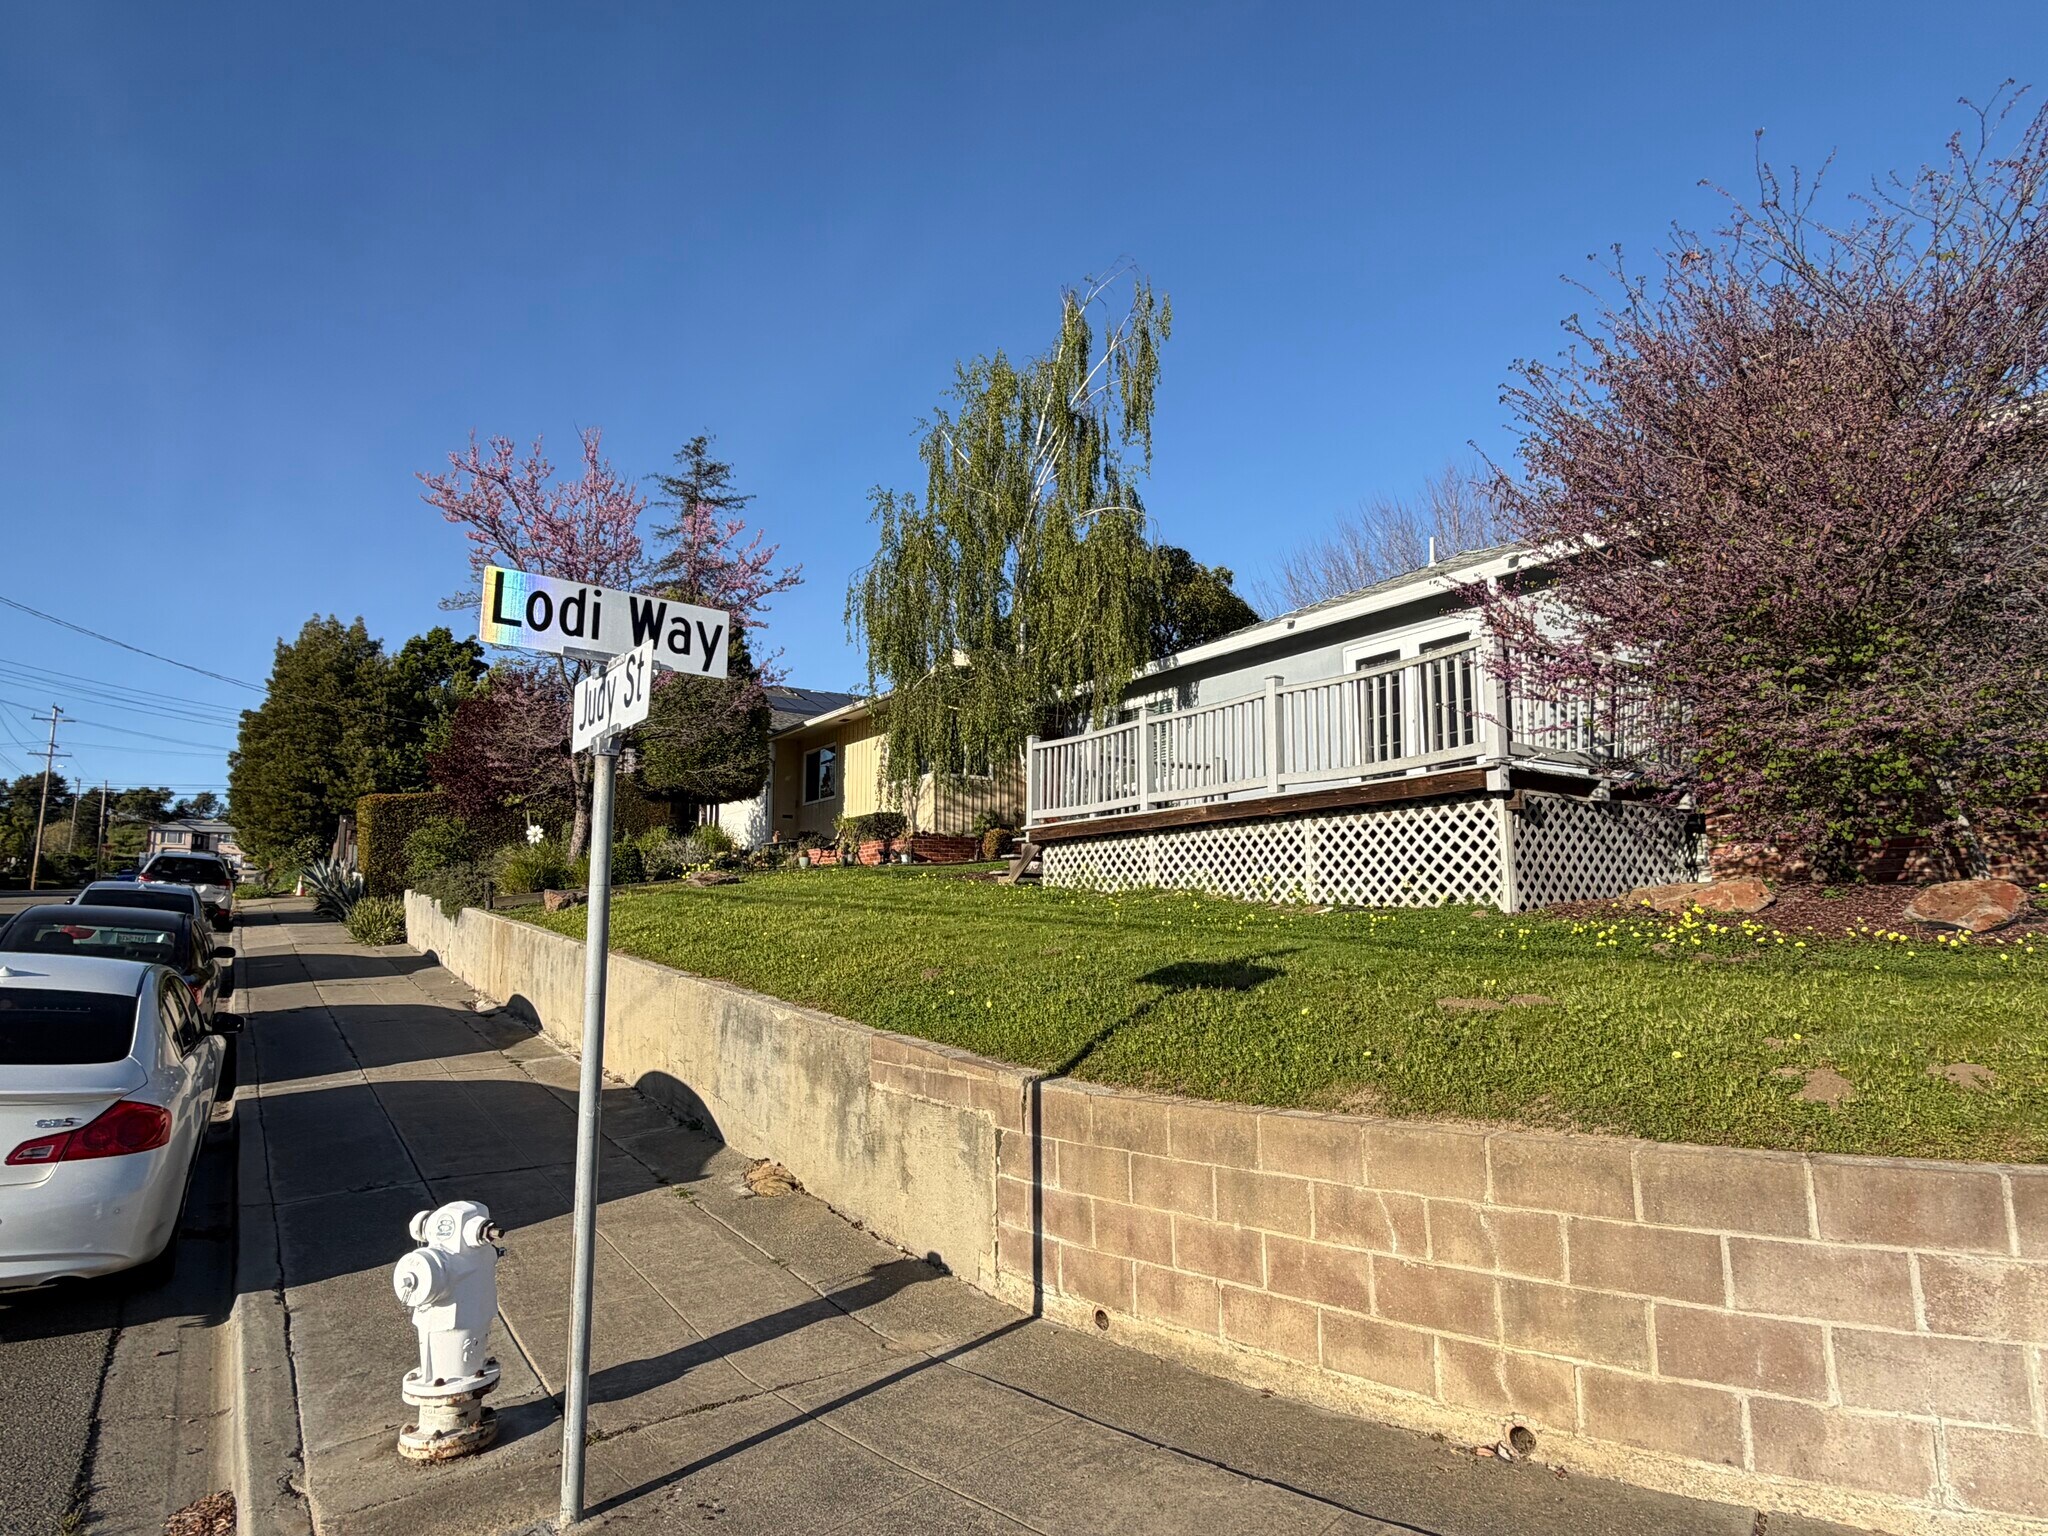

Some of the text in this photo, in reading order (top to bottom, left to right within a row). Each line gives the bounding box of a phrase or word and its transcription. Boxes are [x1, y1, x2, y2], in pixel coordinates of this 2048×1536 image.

[492, 571, 723, 672] Lodi Way
[578, 650, 645, 731] Judy St
